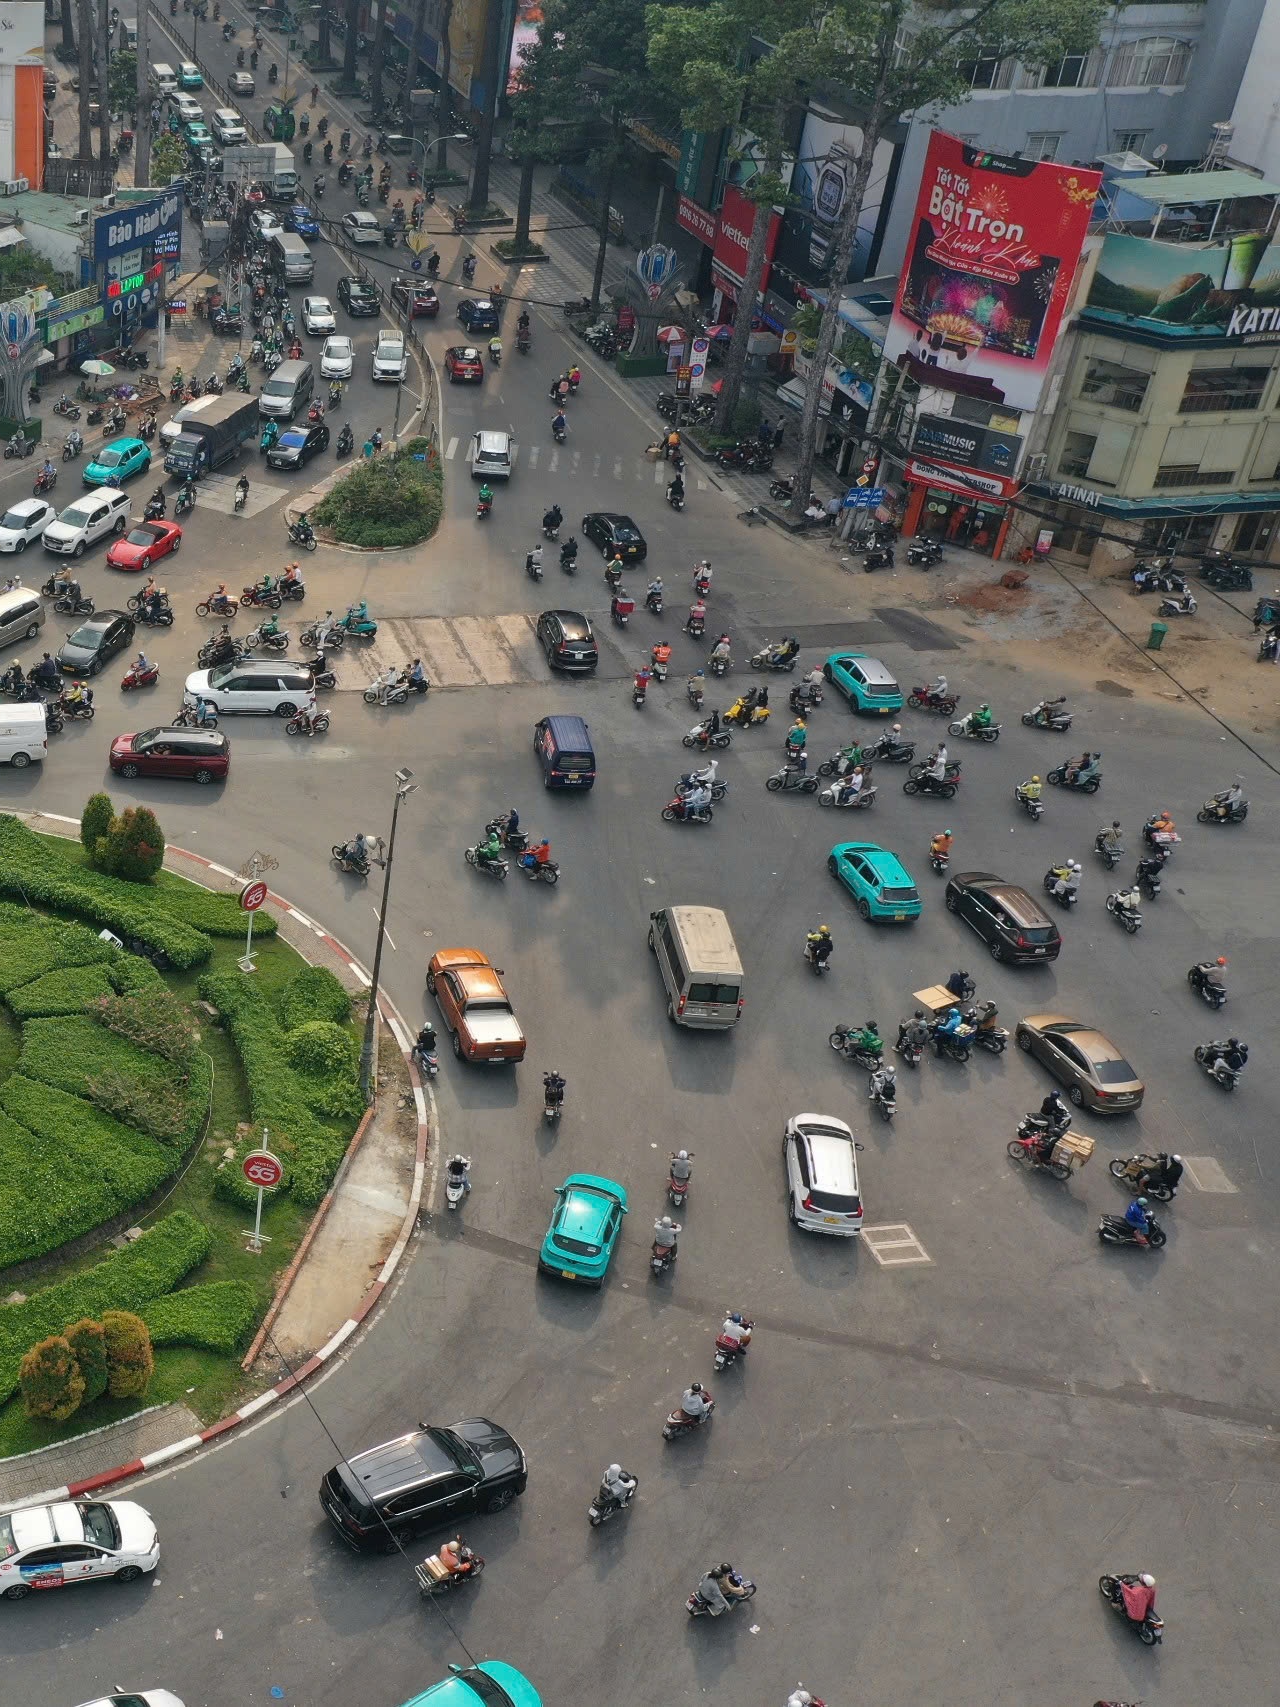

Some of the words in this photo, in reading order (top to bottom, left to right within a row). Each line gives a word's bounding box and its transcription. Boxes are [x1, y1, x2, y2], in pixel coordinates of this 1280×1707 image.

[936, 167, 952, 186] Tết
[953, 174, 970, 197] Tất
[929, 185, 964, 230] Bật
[966, 207, 1024, 244] Trọn
[109, 220, 132, 247] Bảo
[135, 208, 160, 237] Hành
[721, 221, 750, 251] viettel
[120, 273, 144, 293] LAPTOP
[247, 890, 263, 907] 5G
[248, 1164, 275, 1181] 5G
[35, 1577, 62, 1586] ENEOS
